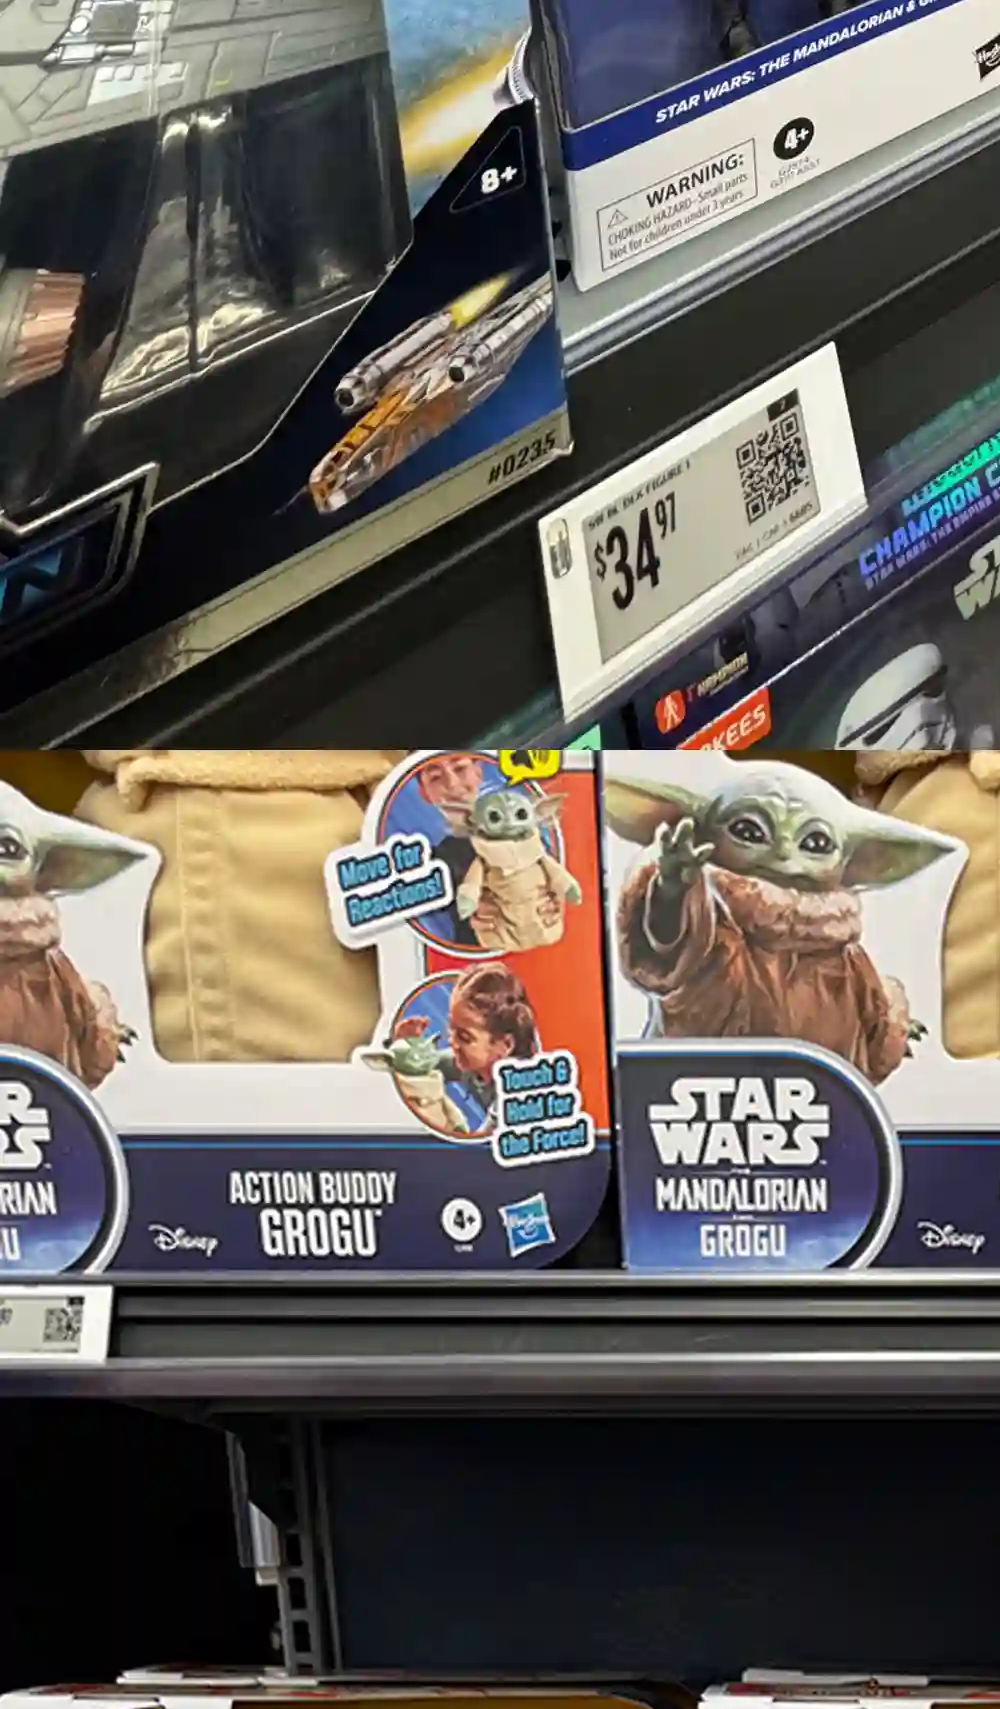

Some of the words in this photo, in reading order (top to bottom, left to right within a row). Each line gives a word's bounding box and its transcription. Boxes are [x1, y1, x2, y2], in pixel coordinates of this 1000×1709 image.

[655, 94, 701, 124] STAR
[702, 69, 757, 104] WARS:
[760, 53, 790, 78] THE
[792, 6, 905, 64] MANDALORIAN
[783, 126, 810, 151] 4+
[480, 165, 519, 195] 8+
[646, 152, 746, 209] WARNING:
[609, 244, 628, 261] Not
[629, 236, 644, 253] for
[644, 219, 683, 245] children
[683, 205, 712, 226] under
[719, 191, 744, 209] years
[858, 480, 982, 576] CHAMPION
[864, 566, 895, 590] STAR
[339, 853, 391, 892] Move
[393, 840, 426, 870] for
[346, 875, 446, 927] Reactions!
[501, 1064, 552, 1089] Touch
[505, 1099, 542, 1125] Hold
[544, 1094, 574, 1120] for
[648, 1076, 830, 1121] STAR
[500, 1134, 530, 1160] the
[532, 1122, 588, 1153] Force!
[648, 1122, 830, 1165] WARS
[229, 1171, 316, 1206] ACTION
[320, 1170, 397, 1206] BUDDY
[655, 1177, 828, 1213] MANDALORIAN
[148, 1223, 218, 1256] Disney
[699, 1223, 787, 1258] GROGU
